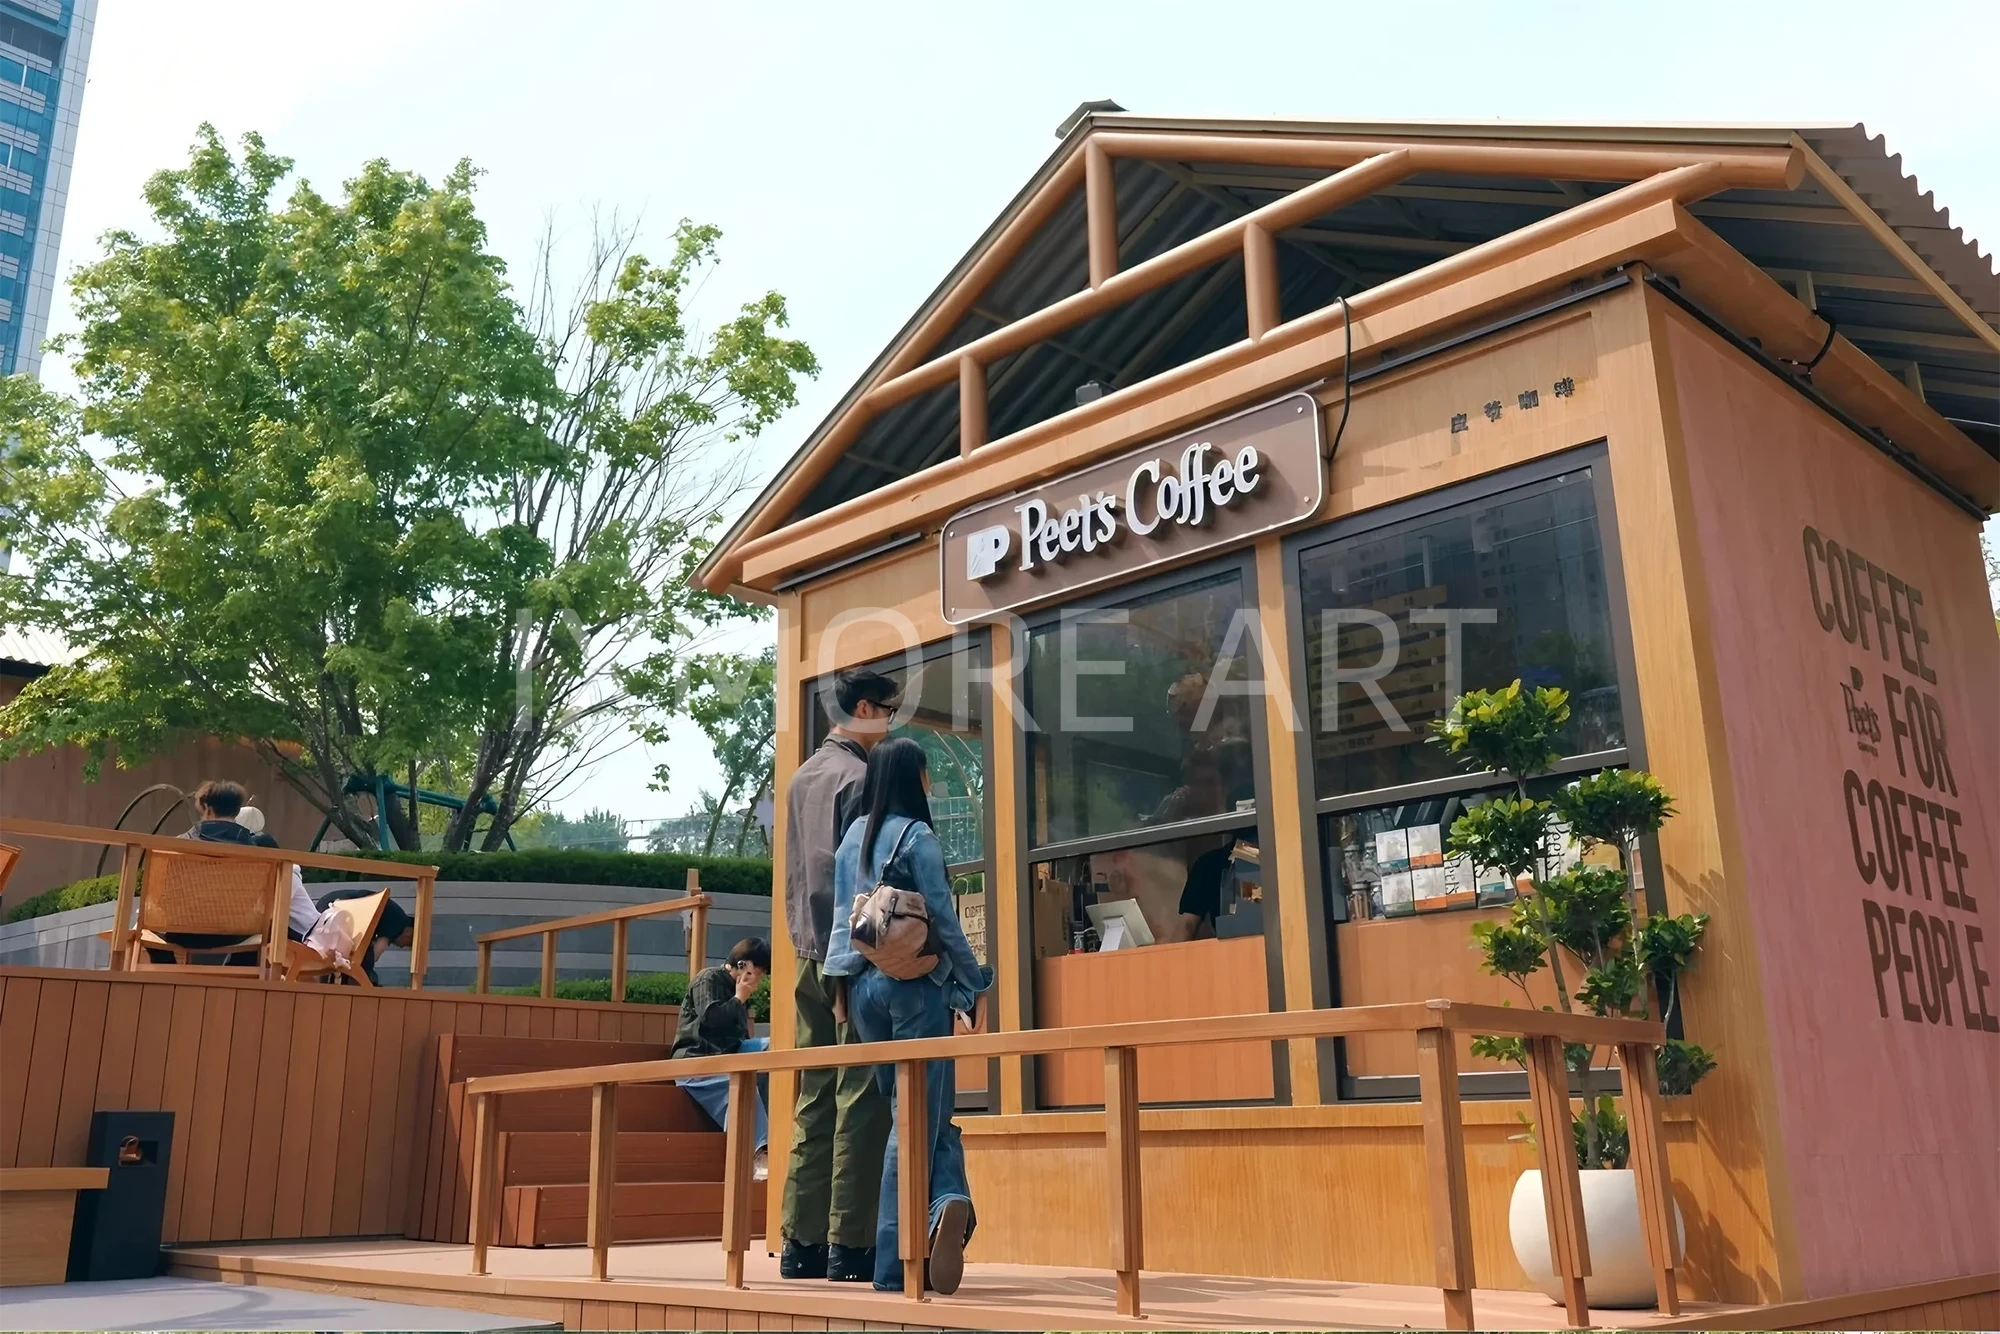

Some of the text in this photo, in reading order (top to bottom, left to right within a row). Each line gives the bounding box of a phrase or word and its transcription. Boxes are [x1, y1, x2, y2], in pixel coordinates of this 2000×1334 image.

[1014, 491, 1116, 571] Peet's
[1126, 442, 1260, 536] Coffee
[1803, 525, 1937, 685] COFFEE
[1883, 673, 1958, 798] FOR
[1843, 769, 1978, 913] COFFEE
[1862, 898, 2000, 1033] PEOPLE
